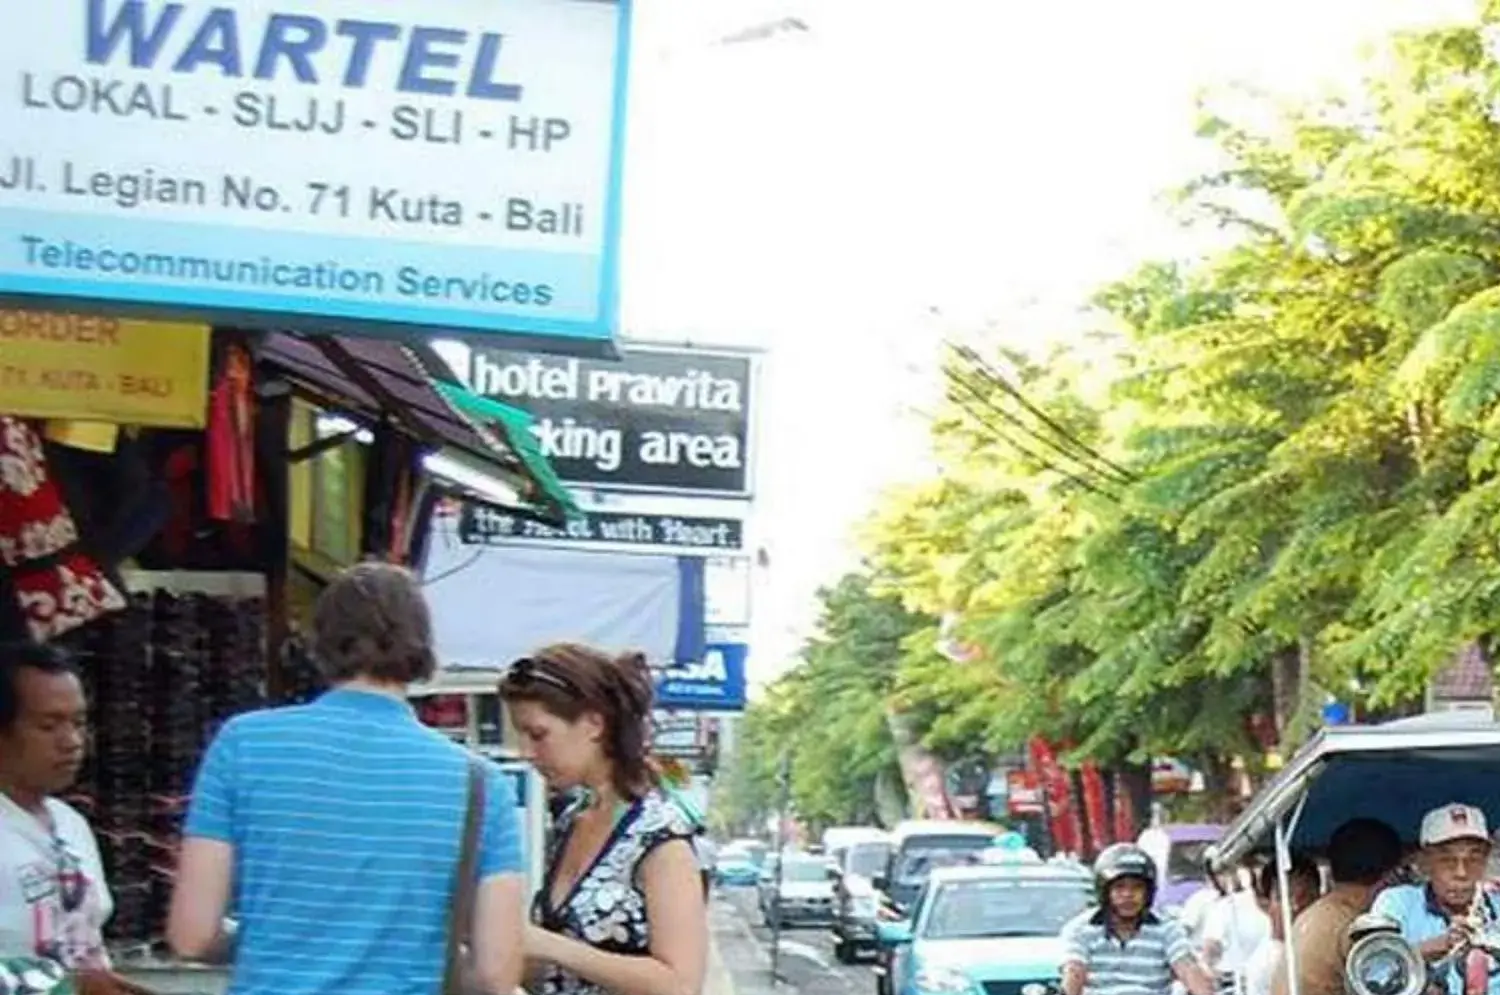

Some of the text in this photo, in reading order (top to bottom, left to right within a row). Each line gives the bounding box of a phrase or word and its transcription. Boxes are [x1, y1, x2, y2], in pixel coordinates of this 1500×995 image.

[86, 0, 523, 101] WARTEL
[22, 72, 190, 121] LOKAL
[232, 91, 345, 135] SLJJ
[390, 104, 463, 145] SLI
[507, 114, 571, 153] HP
[63, 161, 206, 209] Legian
[221, 175, 292, 213] No.
[307, 181, 351, 218] 71
[368, 186, 463, 227] Kuta
[505, 197, 585, 237] Bali
[20, 234, 554, 307] Telecommunication Services
[0, 310, 121, 345] ORDER
[474, 354, 579, 400] hotel
[638, 430, 741, 468] area
